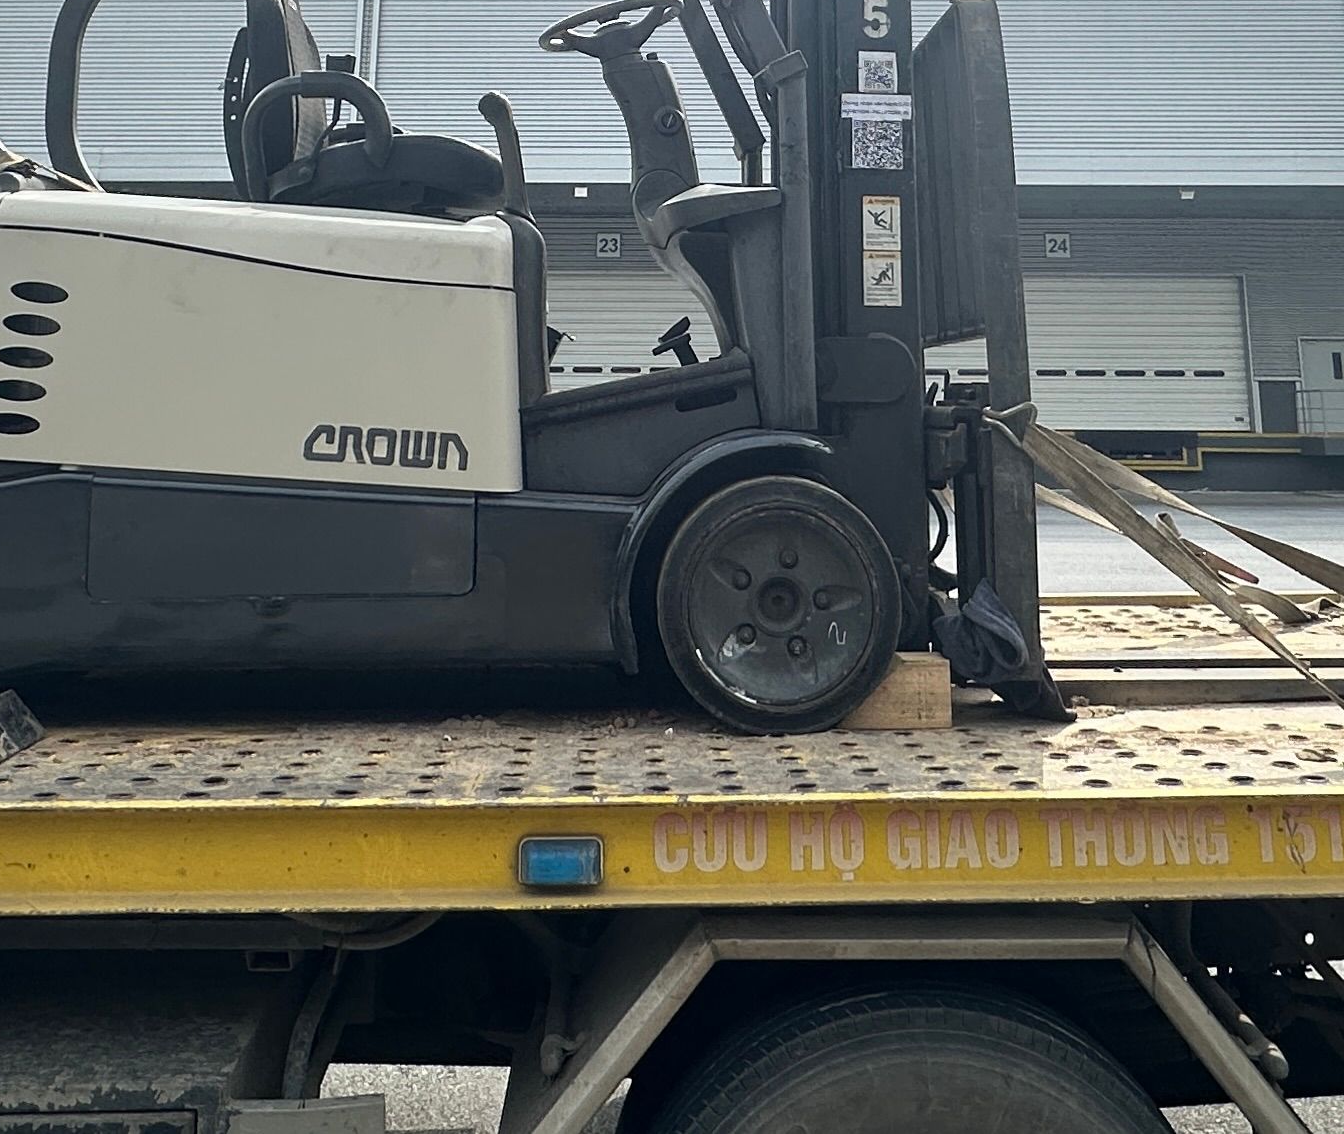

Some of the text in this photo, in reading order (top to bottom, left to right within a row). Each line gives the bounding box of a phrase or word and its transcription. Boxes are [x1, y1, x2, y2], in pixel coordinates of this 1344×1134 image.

[598, 237, 619, 253] 23
[1048, 238, 1068, 254] 24
[303, 424, 469, 471] CROWN
[789, 801, 865, 881] HỘ
[887, 808, 1020, 869] GIAO
[1039, 800, 1230, 867] THÔNG
[1251, 803, 1344, 867] 151
